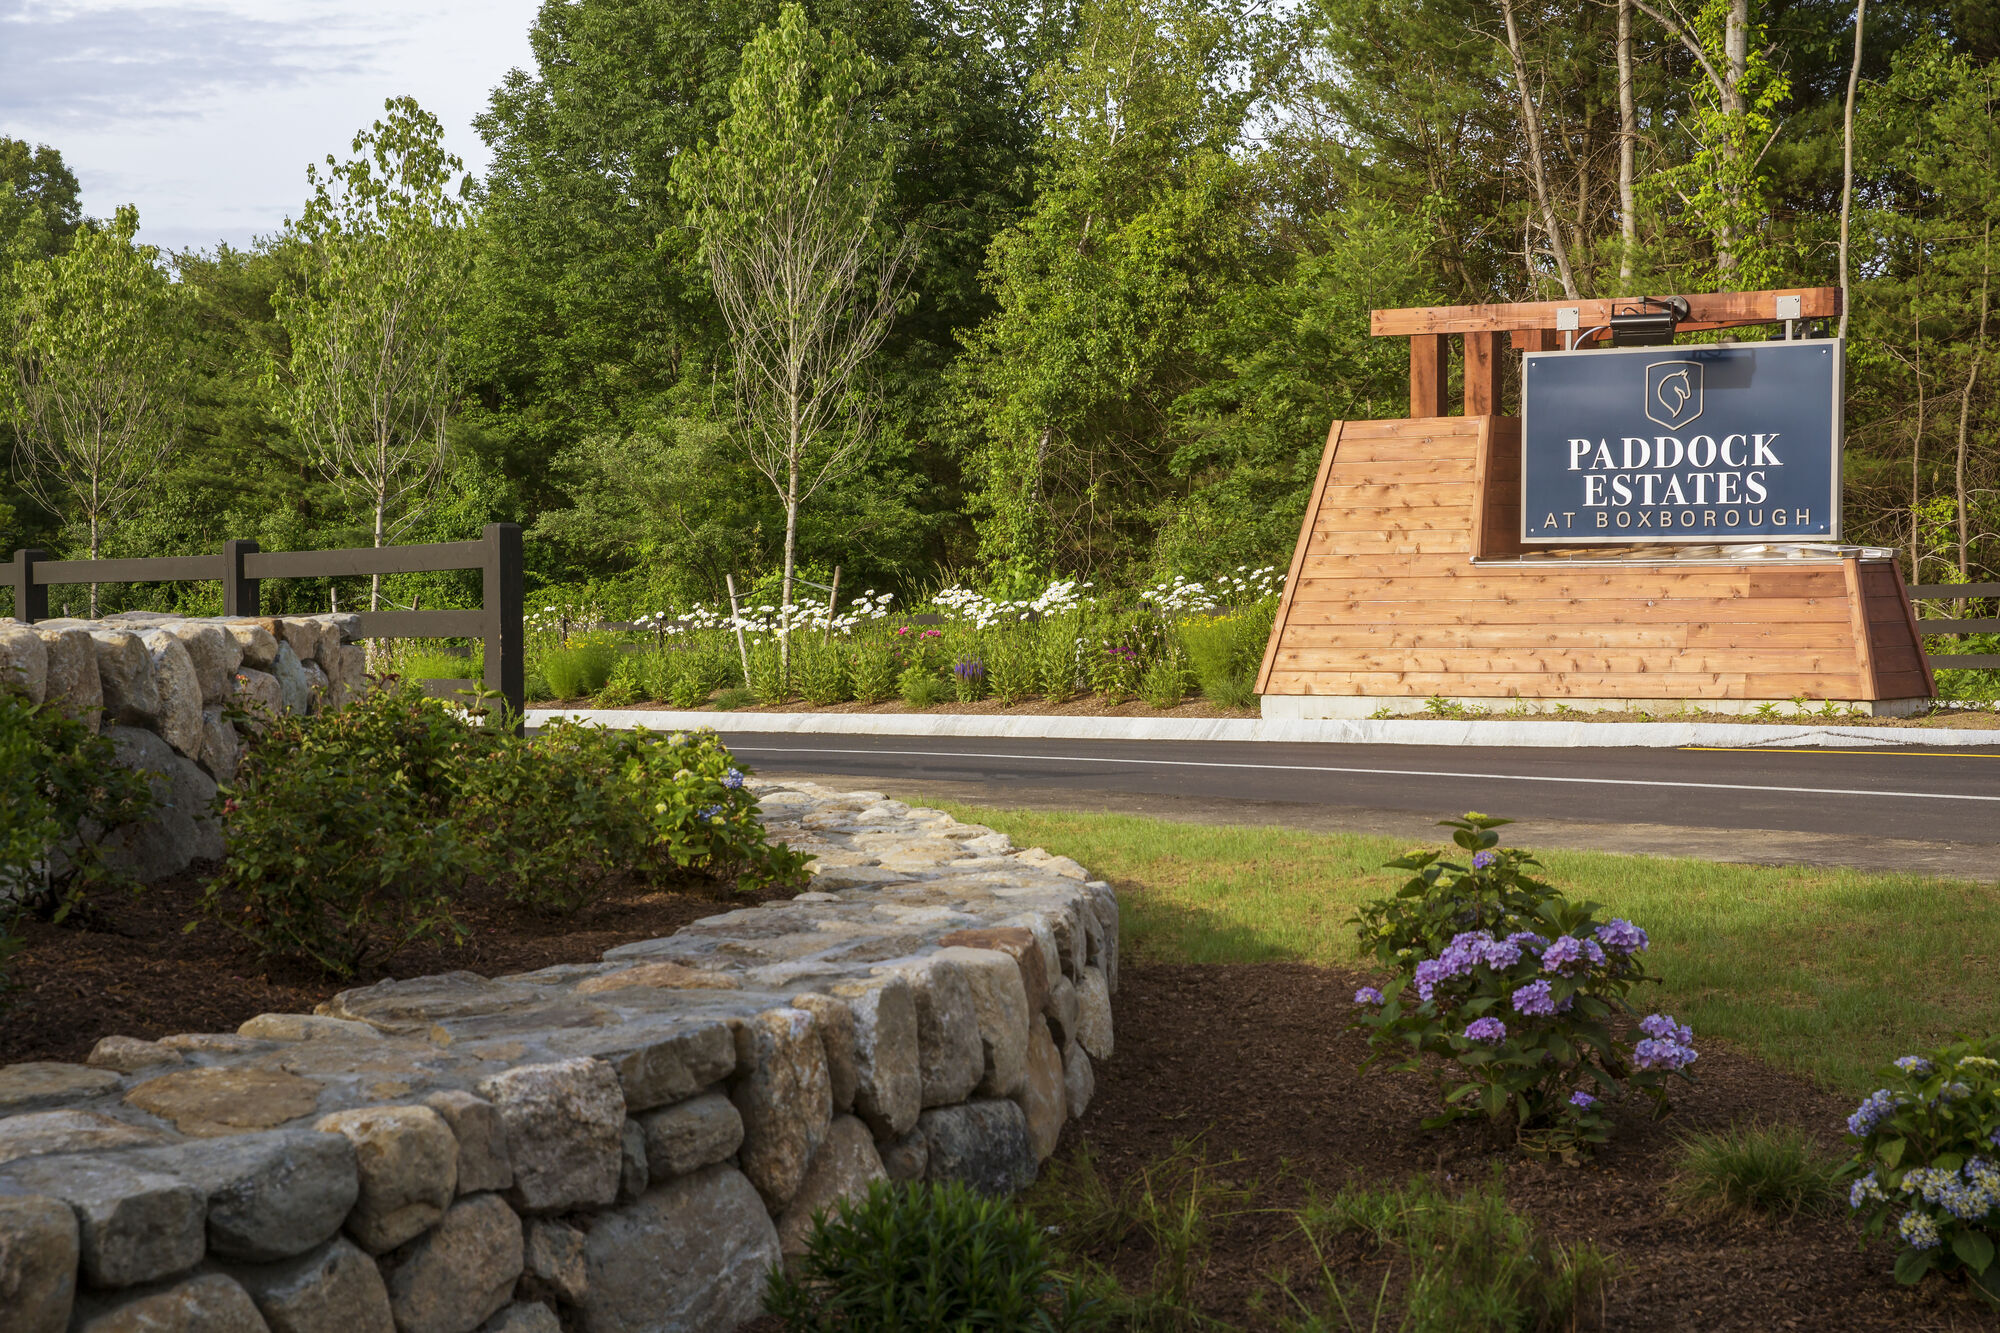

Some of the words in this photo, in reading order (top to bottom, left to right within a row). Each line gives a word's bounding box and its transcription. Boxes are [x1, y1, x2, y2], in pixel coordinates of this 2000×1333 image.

[1567, 433, 1784, 471] PADDOCK
[1582, 471, 1769, 507] ESTATES
[1543, 511, 1576, 529] AT
[1596, 508, 1811, 528] BOXBOROUGH
